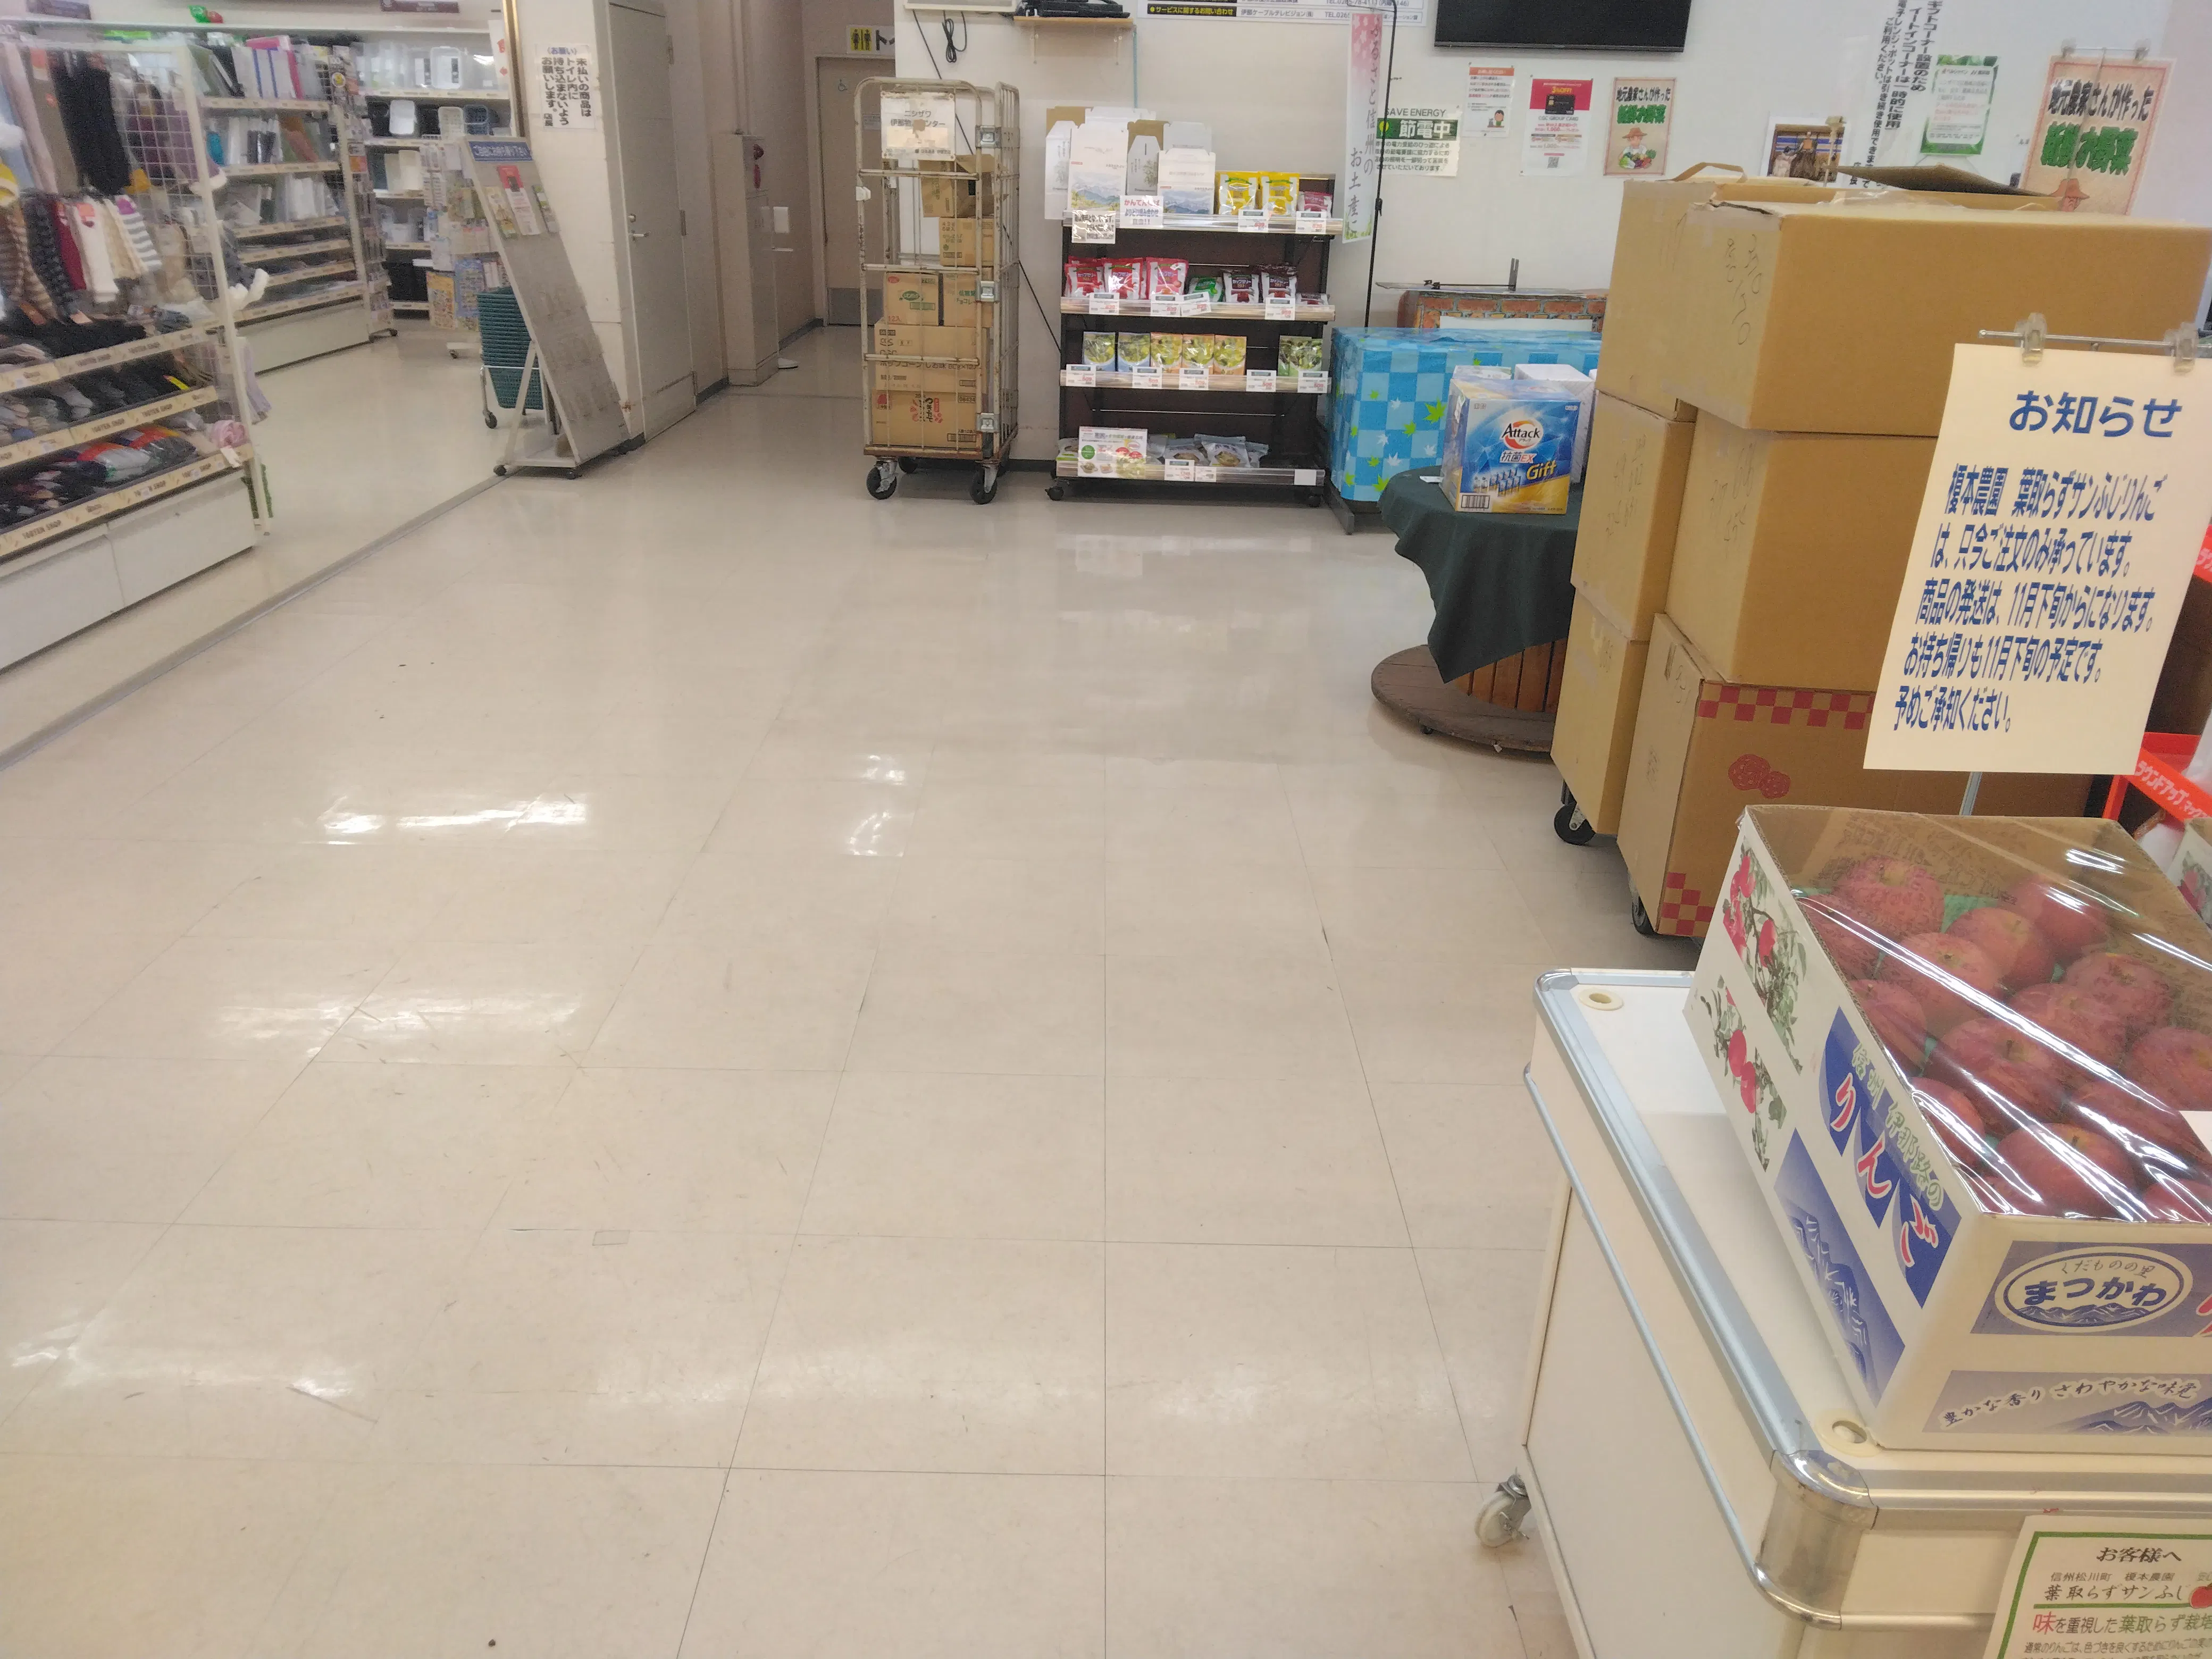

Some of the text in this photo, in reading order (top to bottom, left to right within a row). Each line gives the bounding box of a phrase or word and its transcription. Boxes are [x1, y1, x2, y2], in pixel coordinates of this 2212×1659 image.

[541, 57, 557, 112] お願いします。
[553, 57, 569, 125] 持ち込まないよう
[566, 57, 579, 99] トイレ内に
[576, 58, 591, 117] 未払いの商品は
[1616, 86, 1671, 102] 地元農家さんが作った
[1410, 108, 1446, 117] ENERGY
[2048, 79, 2155, 121] 地元農家さんが作った
[890, 119, 946, 127] 伊那物ンター
[1399, 120, 1451, 139] 節電中
[1501, 423, 1542, 439] Attack
[2008, 389, 2183, 438] お知らせ
[1501, 451, 1535, 463] 抗菌EX
[1526, 459, 1557, 481] Gift
[1944, 463, 2168, 522] 榎本農園 葉取らずサンふじりんご
[1930, 522, 2133, 578] は、只今ご注文のみ承っています。
[1915, 576, 2156, 633] 商品の発送は、11月下旬からになります。
[1903, 631, 2104, 684] お持ち帰りも11月下旬の予定です。
[1893, 684, 2011, 733] 予めご承知ください。
[2062, 1259, 2156, 1279] くだものの里
[2024, 1276, 2167, 1307] まつかわ
[1942, 1379, 2197, 1428] 豊かな香り さわやかな味覚
[2096, 1547, 2182, 1563] お客様へ
[2045, 1583, 2190, 1602] 葉取らずサンふじ
[2050, 1572, 2175, 1582] 信州松川町 榎本農園
